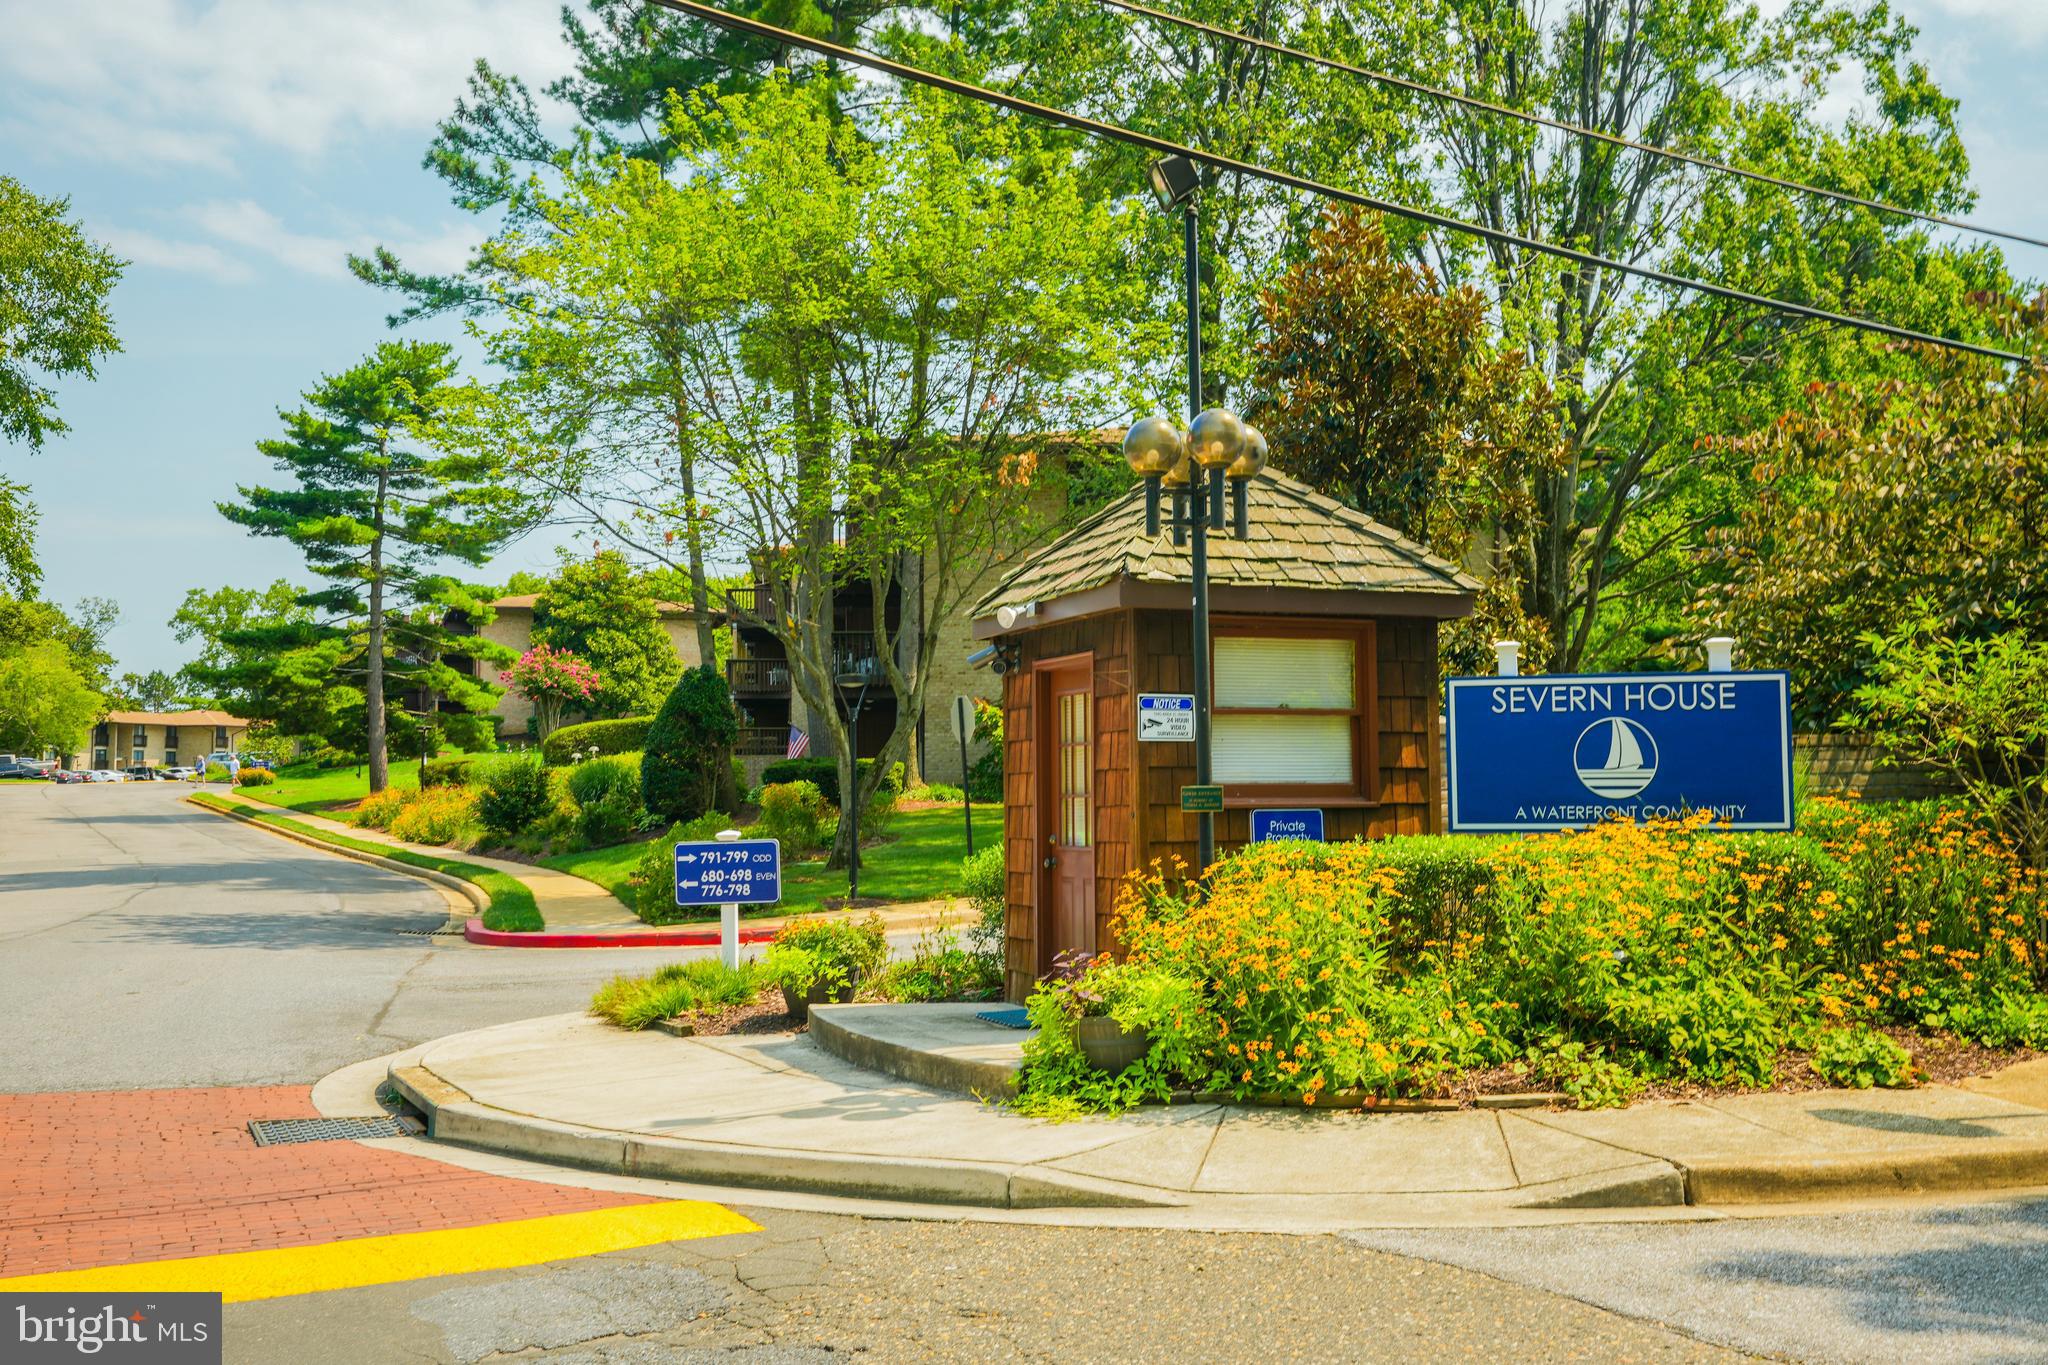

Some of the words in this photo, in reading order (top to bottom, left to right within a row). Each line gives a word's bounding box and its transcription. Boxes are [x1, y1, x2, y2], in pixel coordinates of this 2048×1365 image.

[1152, 698, 1181, 709] NOTICE
[1491, 685, 1612, 714] SEVERN
[1625, 682, 1736, 711] HOUSE
[1515, 806, 1528, 819] A
[1532, 804, 1638, 820] WATERFRONT
[1270, 819, 1305, 831] Private
[700, 851, 749, 864] 791-799
[752, 854, 772, 863] ODD
[701, 869, 752, 882] 680-698
[755, 872, 776, 880] EVEN
[701, 884, 751, 897] 776-798
